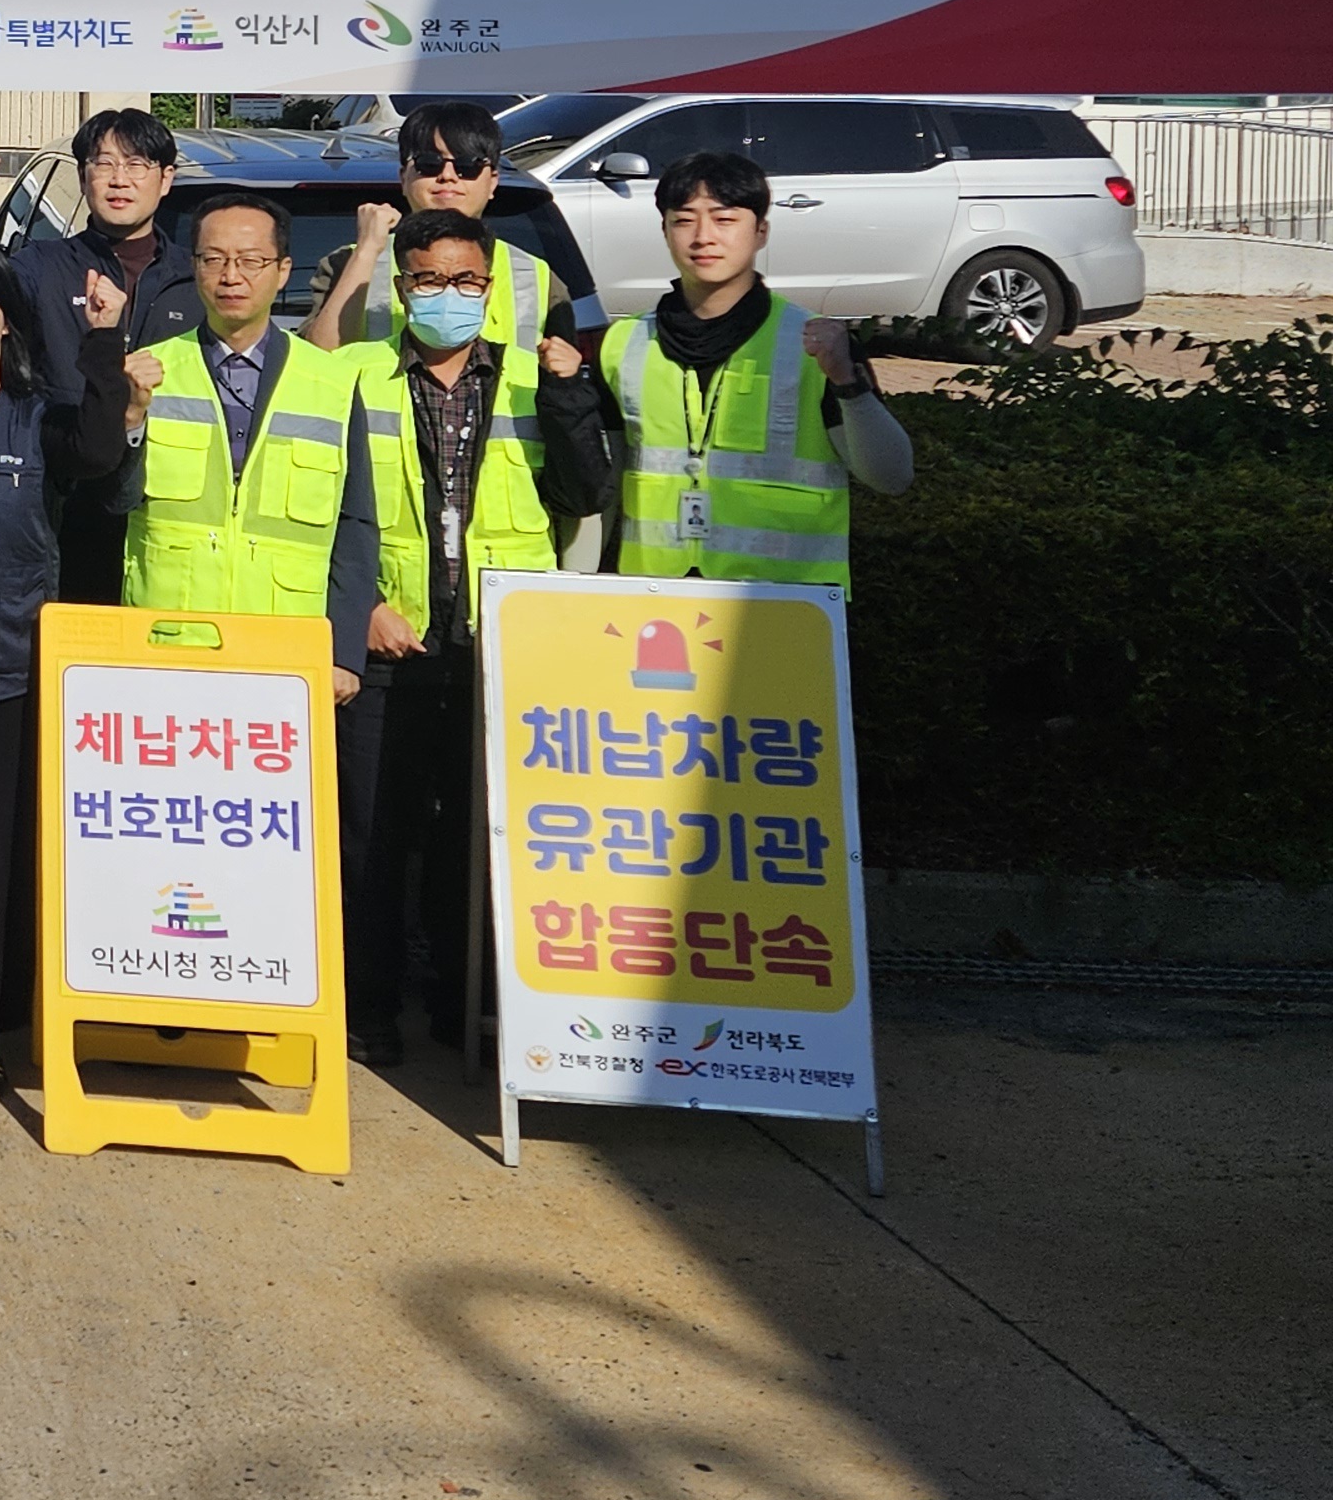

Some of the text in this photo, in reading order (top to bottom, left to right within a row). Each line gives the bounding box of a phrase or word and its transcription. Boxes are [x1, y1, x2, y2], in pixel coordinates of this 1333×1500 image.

[236, 15, 318, 44] 익산시
[420, 18, 499, 37] 완주군
[420, 41, 501, 53] WANJUGUN
[74, 712, 299, 773] 체납차량
[521, 706, 823, 787] 체납차량
[74, 791, 300, 851] 번호판영치
[527, 803, 830, 886] 유관기관
[530, 900, 833, 987] 합동단속
[92, 947, 289, 985] 익산시청 징수과
[612, 1024, 678, 1046] 완주군
[726, 1030, 806, 1053] 전라북도
[559, 1053, 645, 1075] 전북경찰청
[710, 1063, 795, 1084] 한국도로공사
